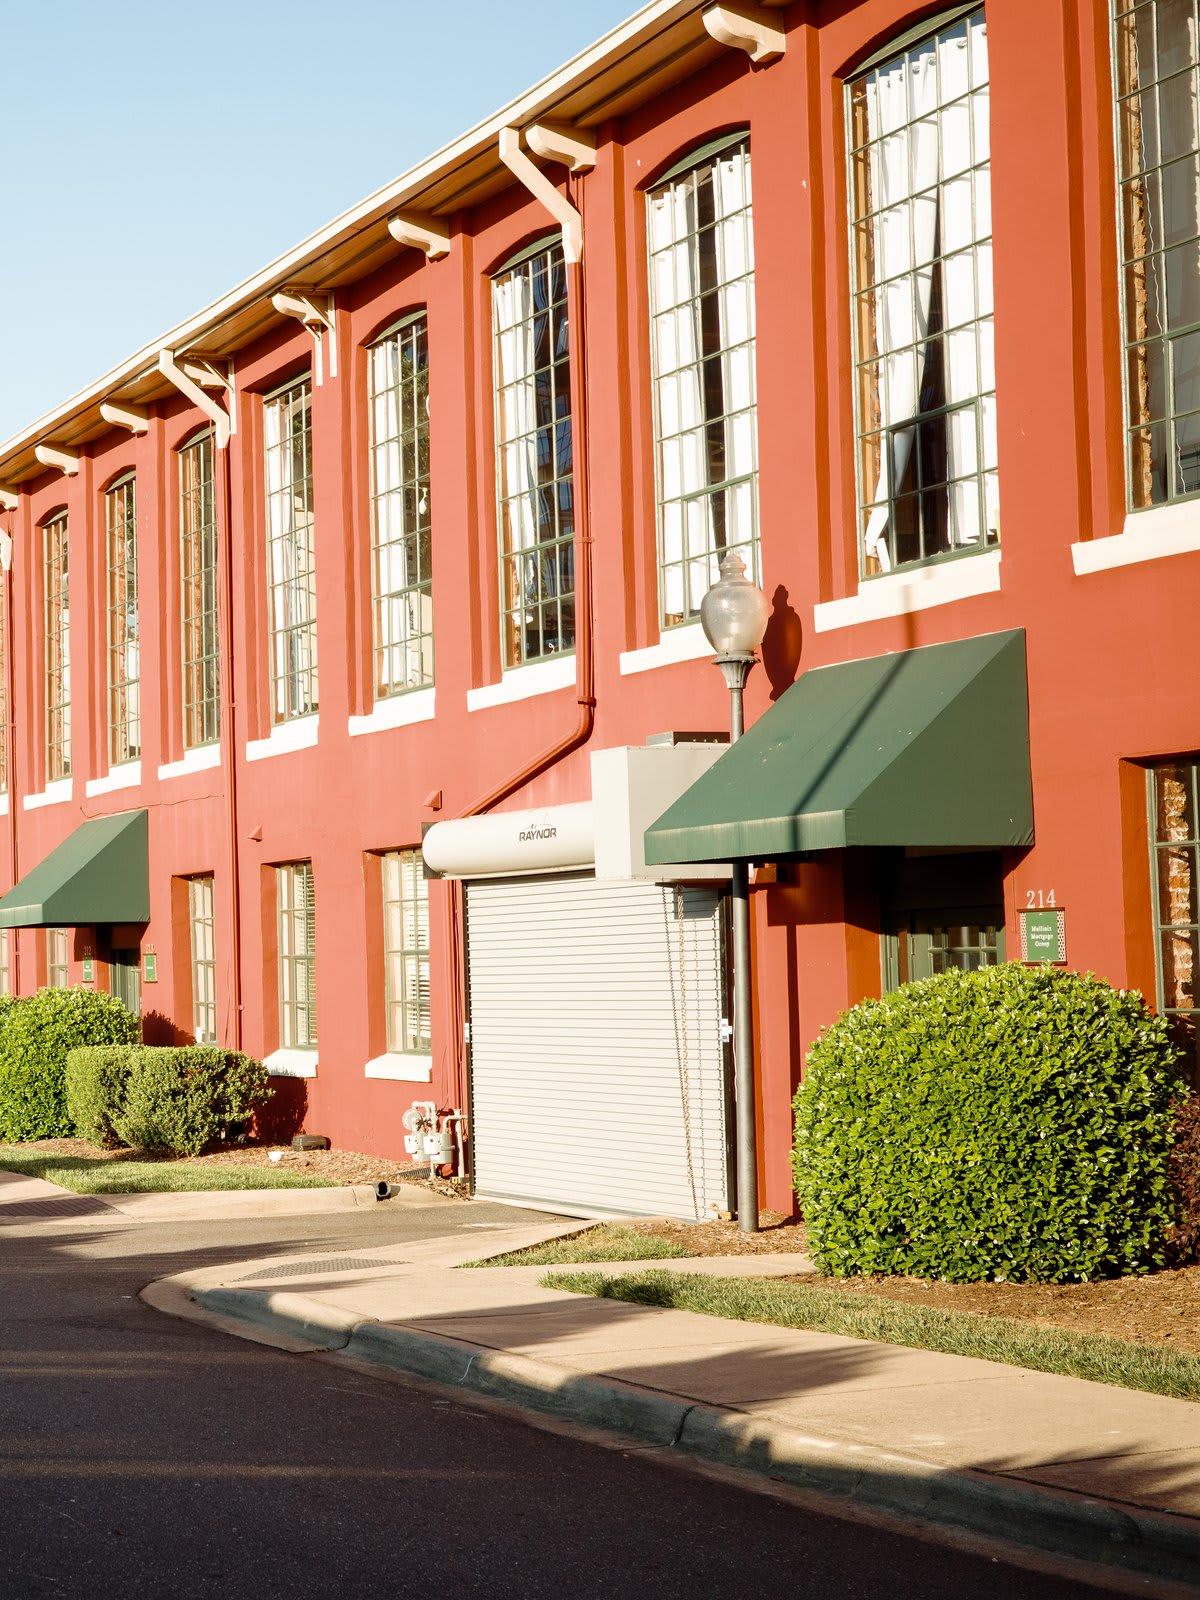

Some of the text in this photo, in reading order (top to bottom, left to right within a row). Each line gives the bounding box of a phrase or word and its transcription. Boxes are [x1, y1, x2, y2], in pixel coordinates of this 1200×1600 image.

[519, 827, 557, 841] RAYNOR
[1026, 889, 1056, 909] 214
[1030, 933, 1053, 941] Mortgage
[1034, 940, 1050, 948] Group
